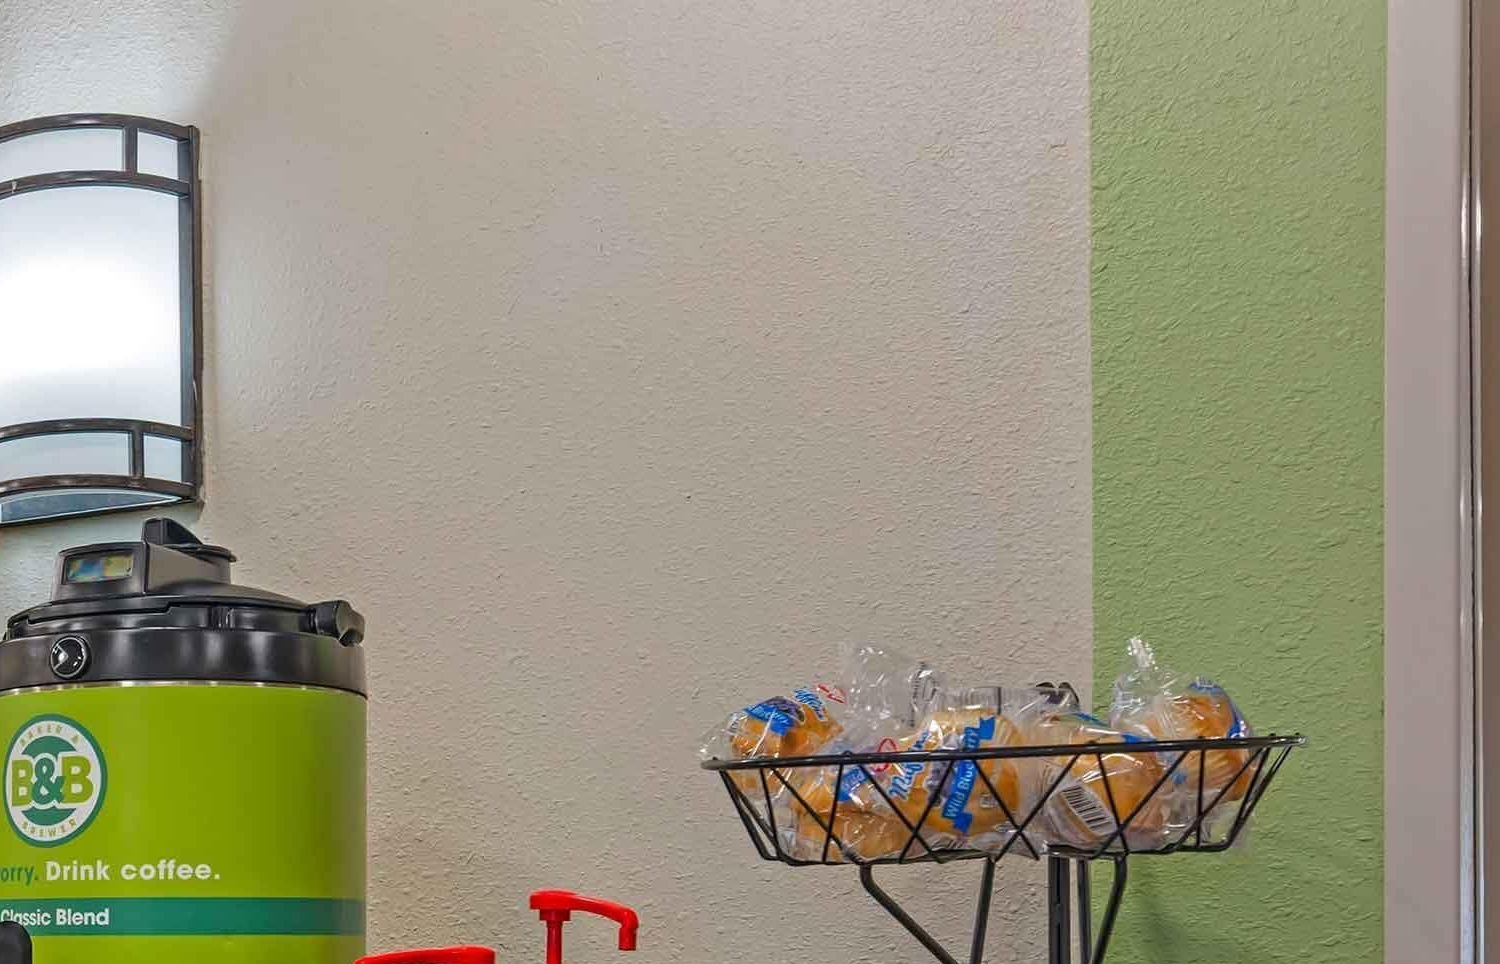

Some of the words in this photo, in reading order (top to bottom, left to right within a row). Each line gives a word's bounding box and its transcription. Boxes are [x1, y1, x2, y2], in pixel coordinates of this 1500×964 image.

[11, 755, 94, 807] B&B
[944, 789, 966, 818] Wild
[960, 726, 981, 791] Bluerry
[45, 860, 111, 881] Drink
[120, 859, 222, 881] coffee.
[0, 908, 51, 926] Classic
[55, 908, 110, 926] Blend
